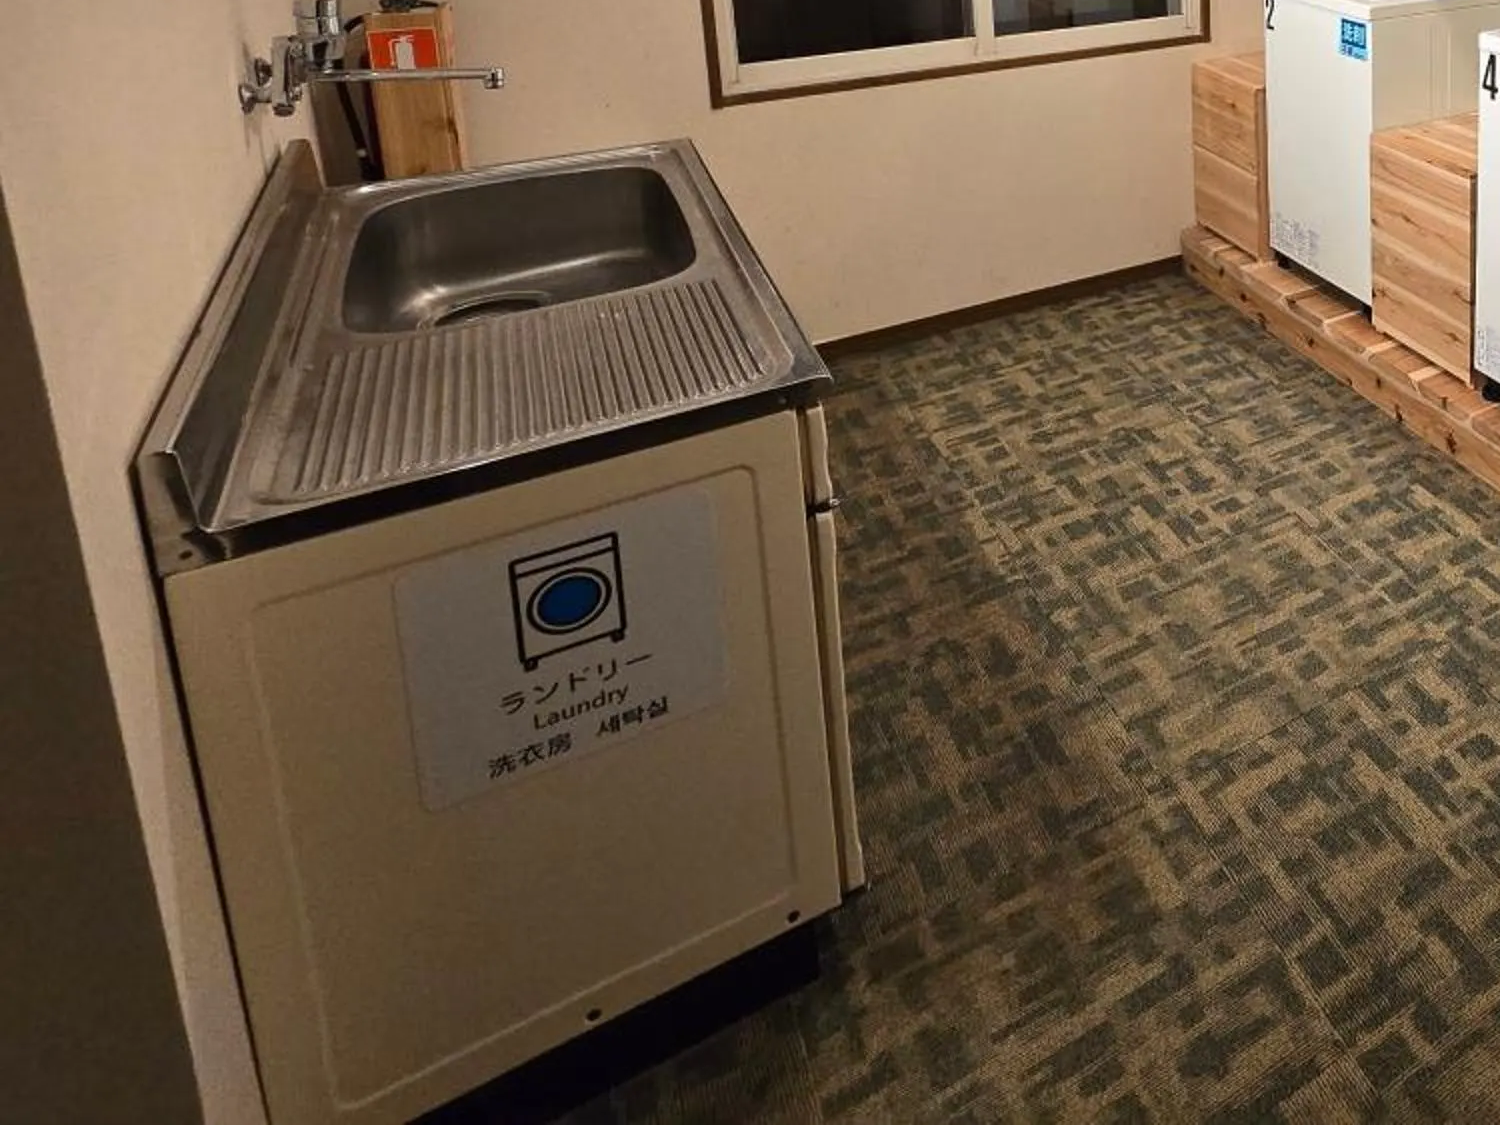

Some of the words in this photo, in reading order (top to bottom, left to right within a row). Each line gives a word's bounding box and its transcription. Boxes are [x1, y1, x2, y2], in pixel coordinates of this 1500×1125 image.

[1482, 54, 1498, 100] 4
[499, 653, 653, 715] ランドリー
[533, 685, 630, 730] Laundry
[488, 732, 572, 779] 洗衣房
[595, 695, 669, 737] 세탁실
